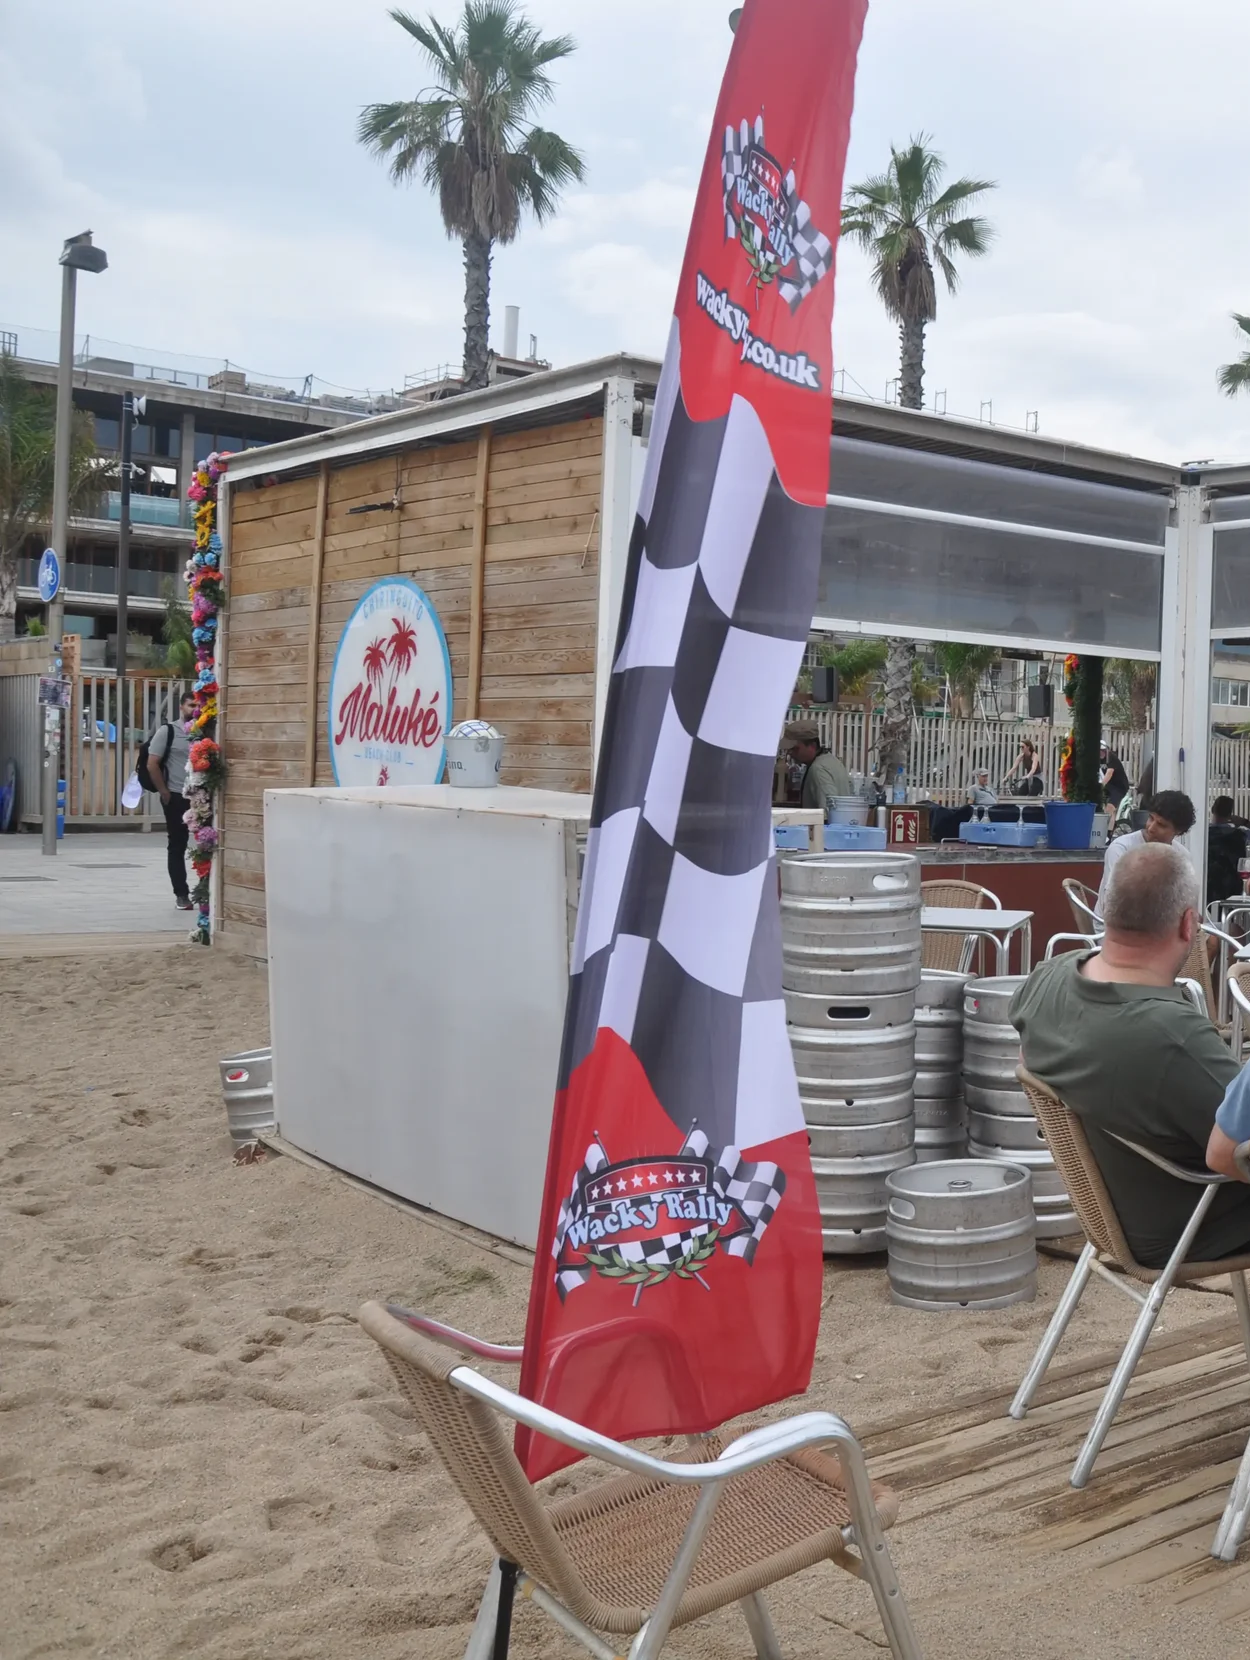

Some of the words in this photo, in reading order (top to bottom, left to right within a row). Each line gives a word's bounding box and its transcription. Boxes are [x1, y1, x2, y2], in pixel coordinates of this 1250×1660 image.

[768, 224, 795, 266] ally
[335, 683, 442, 748] Maluké
[567, 1201, 660, 1250] Wacky
[662, 1192, 733, 1226] Rally
